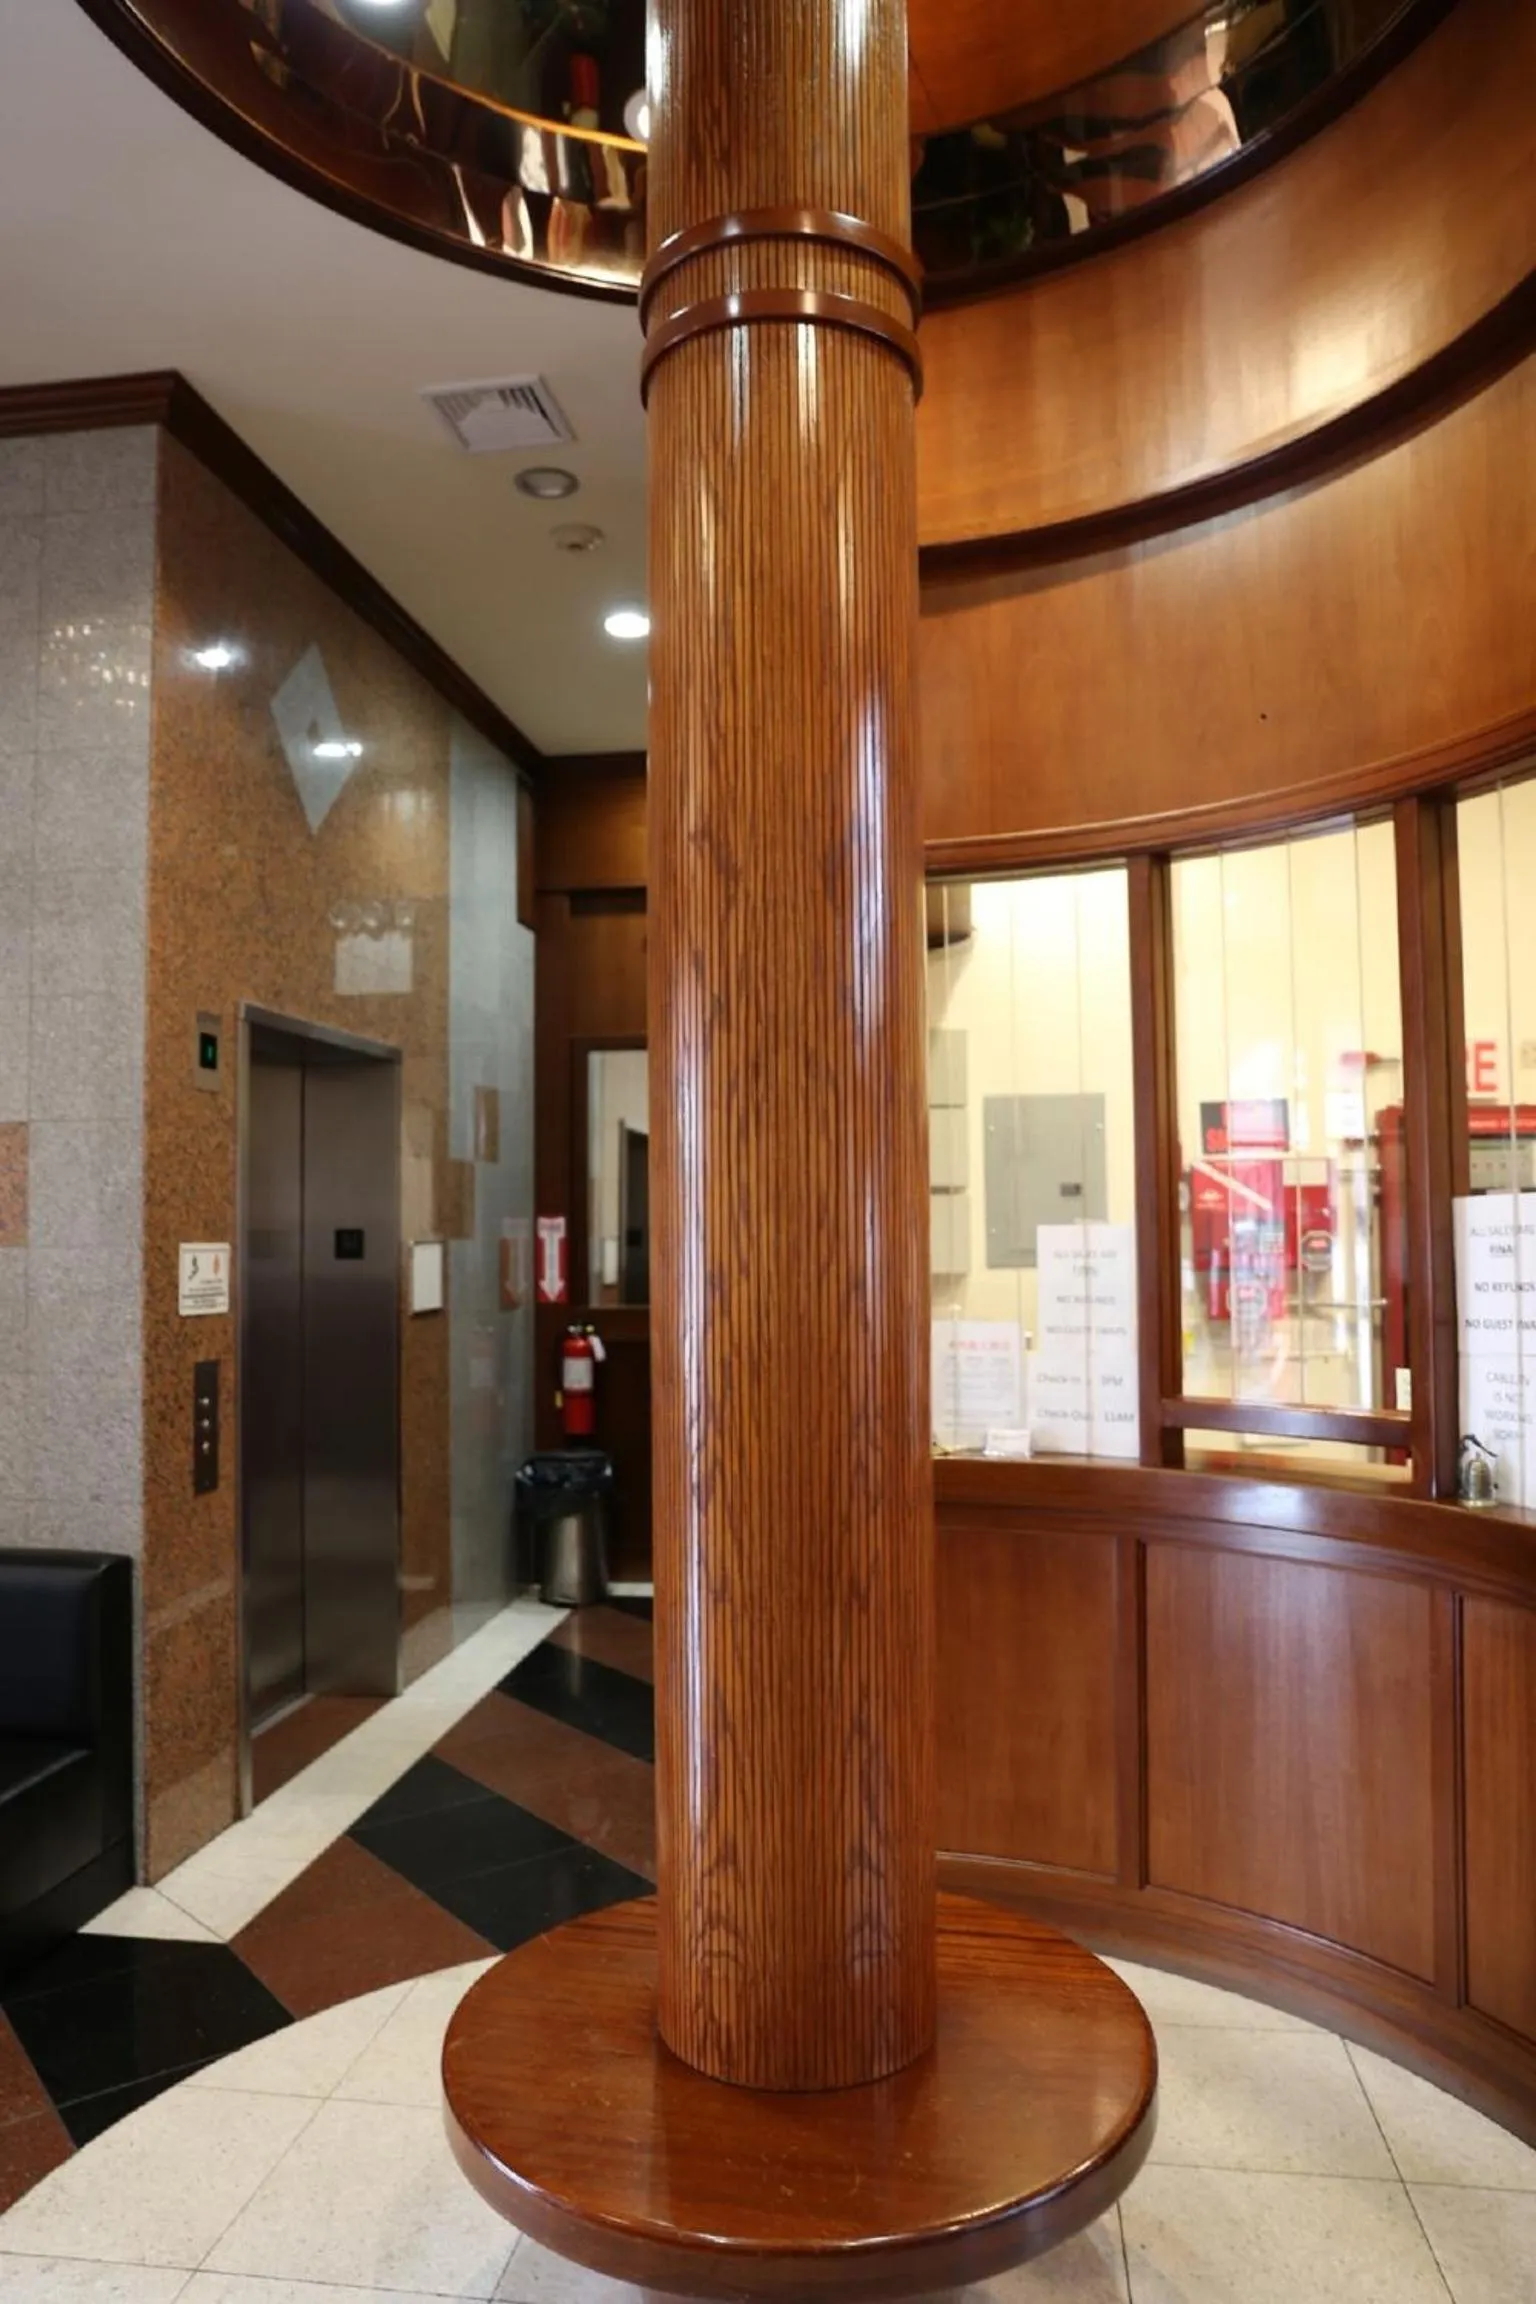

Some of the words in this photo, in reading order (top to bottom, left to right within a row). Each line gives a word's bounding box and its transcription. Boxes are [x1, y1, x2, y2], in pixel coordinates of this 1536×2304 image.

[1489, 1242, 1516, 1255] FINA
[1474, 1281, 1490, 1293] NO
[1465, 1318, 1481, 1329] NO
